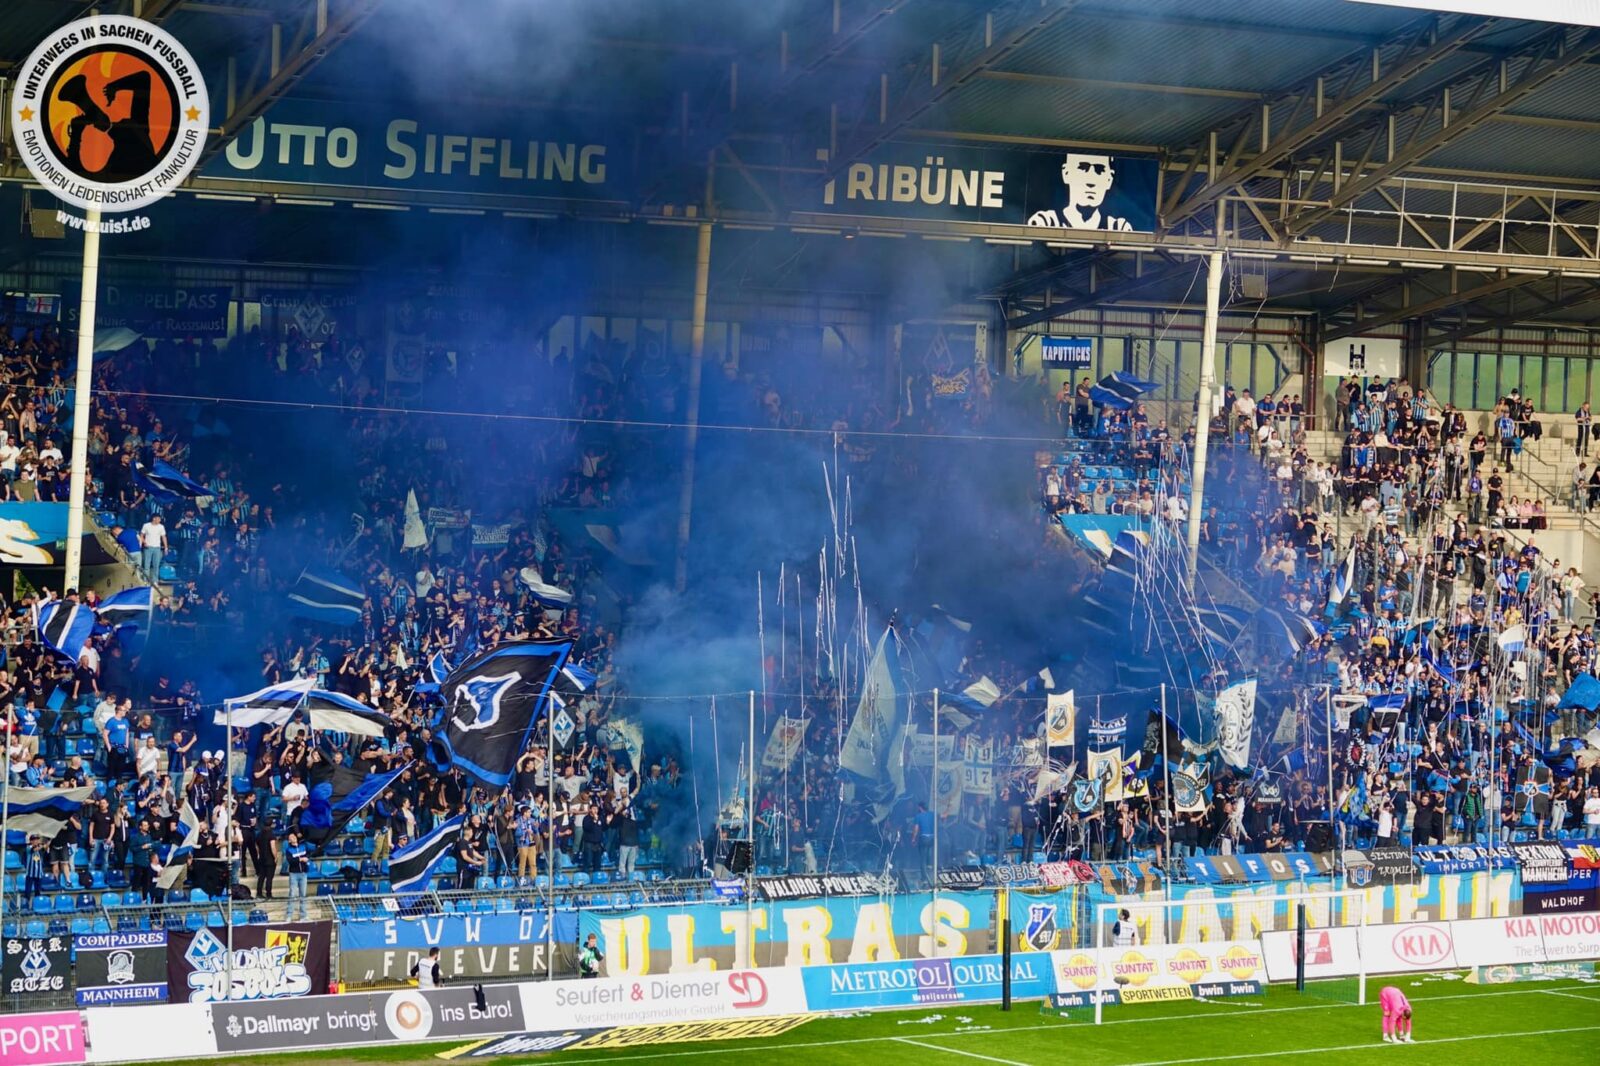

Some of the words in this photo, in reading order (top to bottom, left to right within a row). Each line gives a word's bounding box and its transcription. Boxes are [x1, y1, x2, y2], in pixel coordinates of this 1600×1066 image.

[1042, 345, 1091, 362] KAPUTTICKS
[1349, 344, 1366, 370] H
[1514, 845, 1566, 860] SEKTION
[1522, 866, 1568, 882] MANNHEIM
[1541, 896, 1585, 909] WALDHOF
[1505, 918, 1537, 938] KIA
[77, 931, 164, 948] COMPADRES
[600, 898, 970, 978] ULTRAS
[1402, 937, 1444, 958] KIA
[1515, 946, 1532, 957] The
[1534, 945, 1564, 956] Power
[1566, 945, 1576, 954] to
[1114, 962, 1154, 974] SUNTAT
[1169, 960, 1208, 972] SUNTAT
[1220, 957, 1259, 970] SUNTAT
[82, 986, 160, 1003] MANNHEIM
[556, 983, 624, 1008] Seufert
[631, 983, 644, 1002] &
[651, 980, 721, 1000] Diemer
[1122, 986, 1192, 1002] SPORTWETTEN
[1198, 983, 1224, 996] bwin
[1230, 981, 1255, 994] bwin
[1057, 995, 1083, 1006] bwin
[440, 1003, 465, 1022] ins
[468, 1000, 513, 1020] Büro!
[575, 1006, 688, 1025] Versicherungsmakler
[689, 1003, 725, 1017] GmbH
[243, 1013, 320, 1035] Dallmayr
[326, 1011, 378, 1032] bringt
